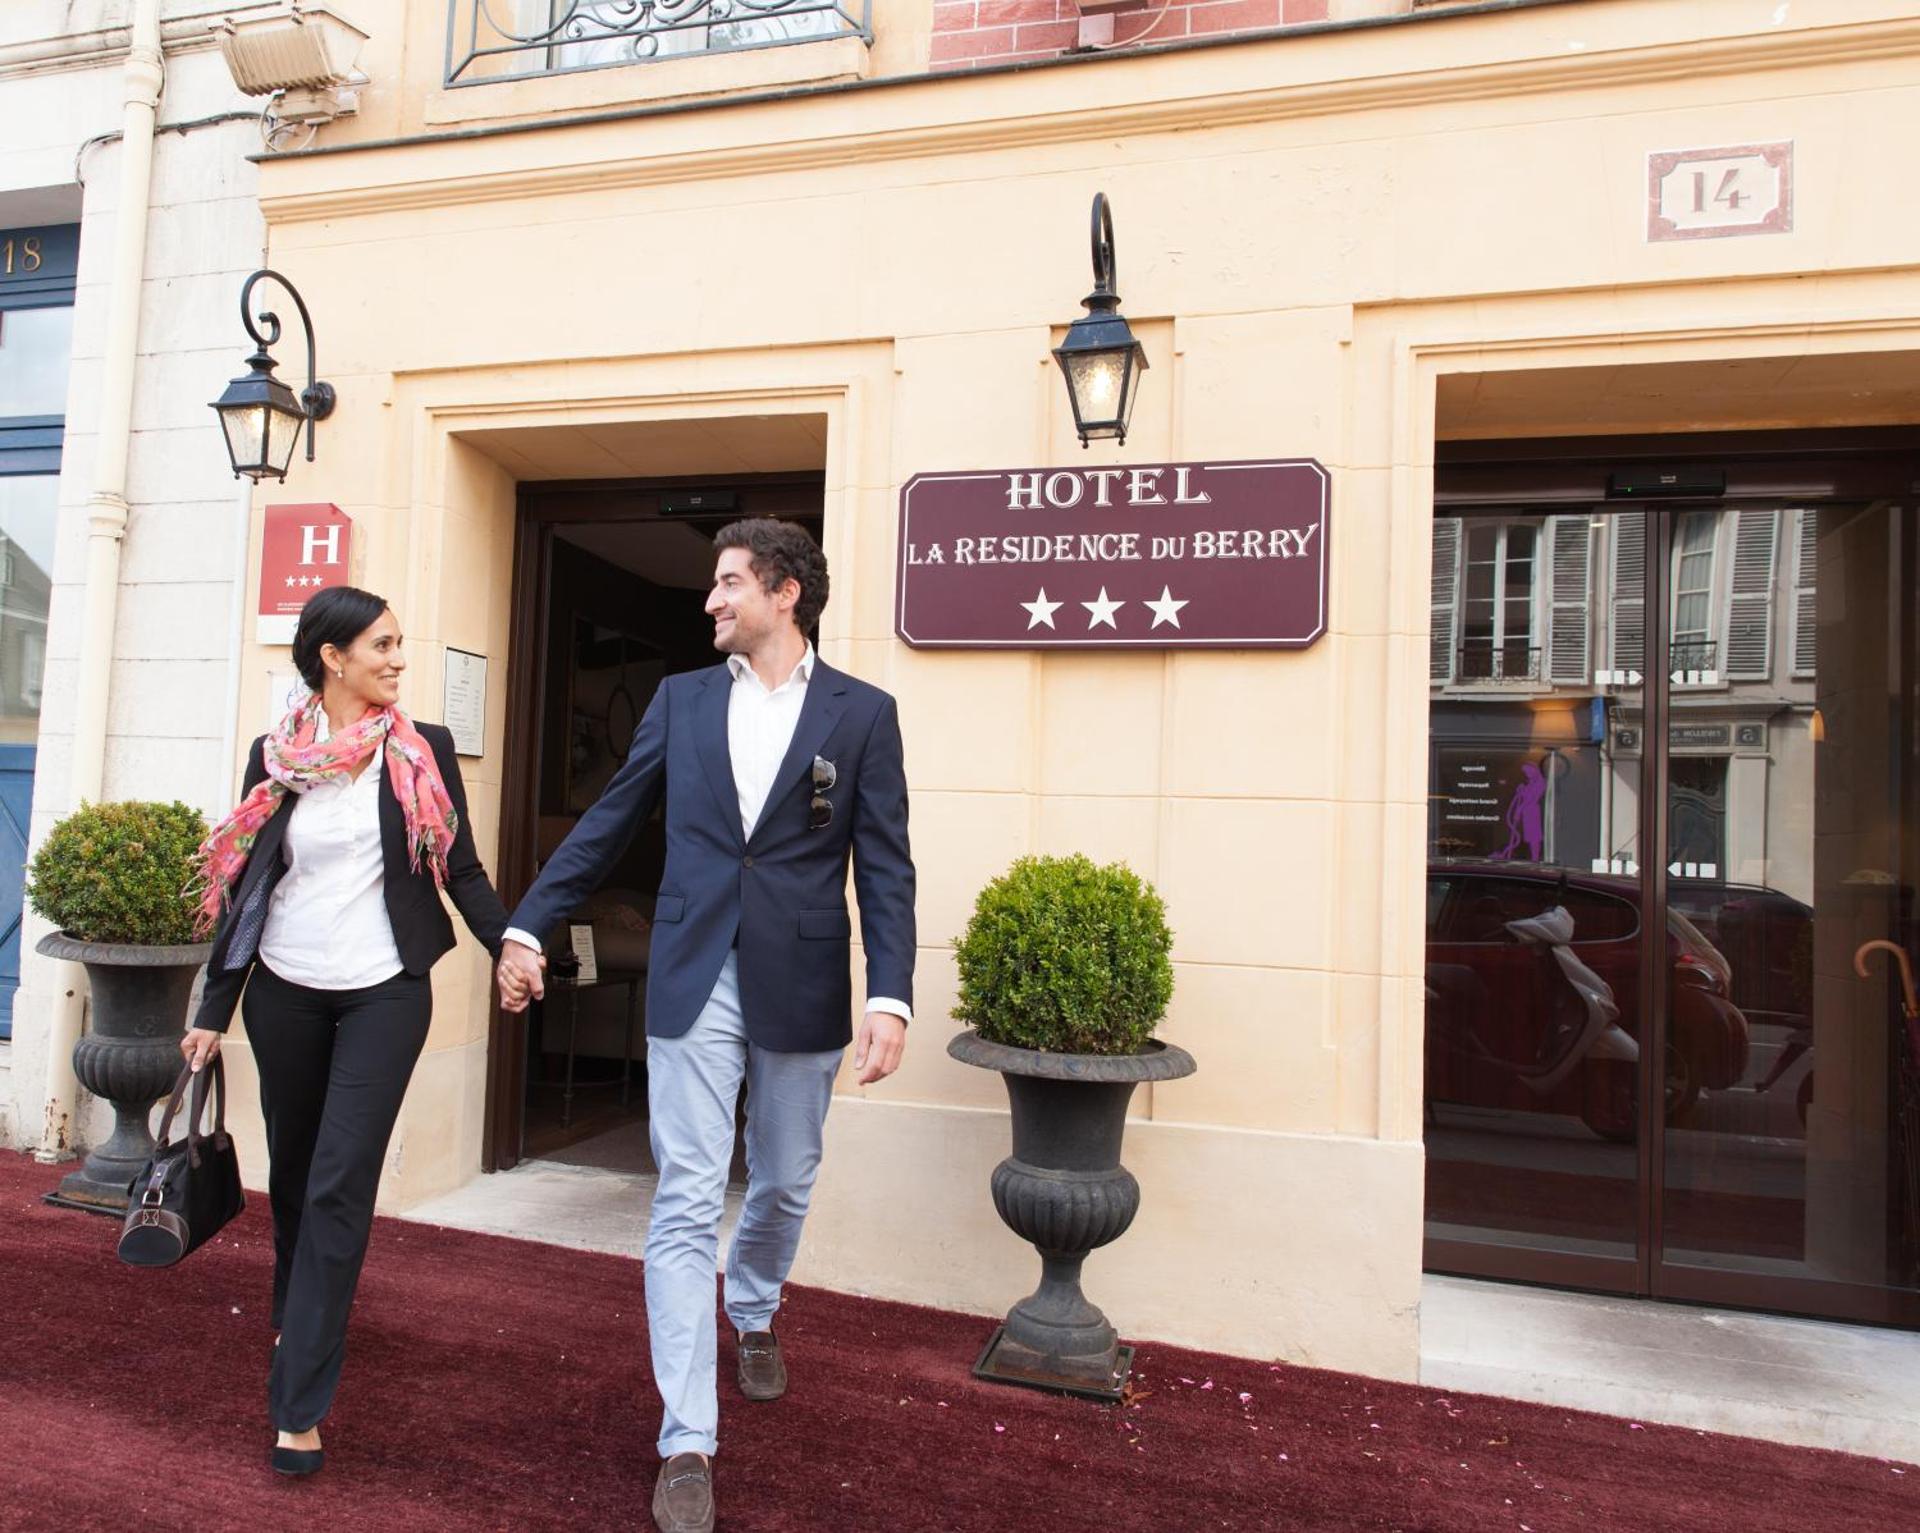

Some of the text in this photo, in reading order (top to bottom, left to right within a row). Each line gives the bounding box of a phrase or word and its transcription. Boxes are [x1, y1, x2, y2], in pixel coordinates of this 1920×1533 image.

[1692, 168, 1751, 213] 14
[4, 236, 41, 274] 18
[1005, 466, 1212, 510] HOTEL
[297, 524, 344, 565] H
[907, 522, 1320, 566] LA RESIDENCE DU BERRY
